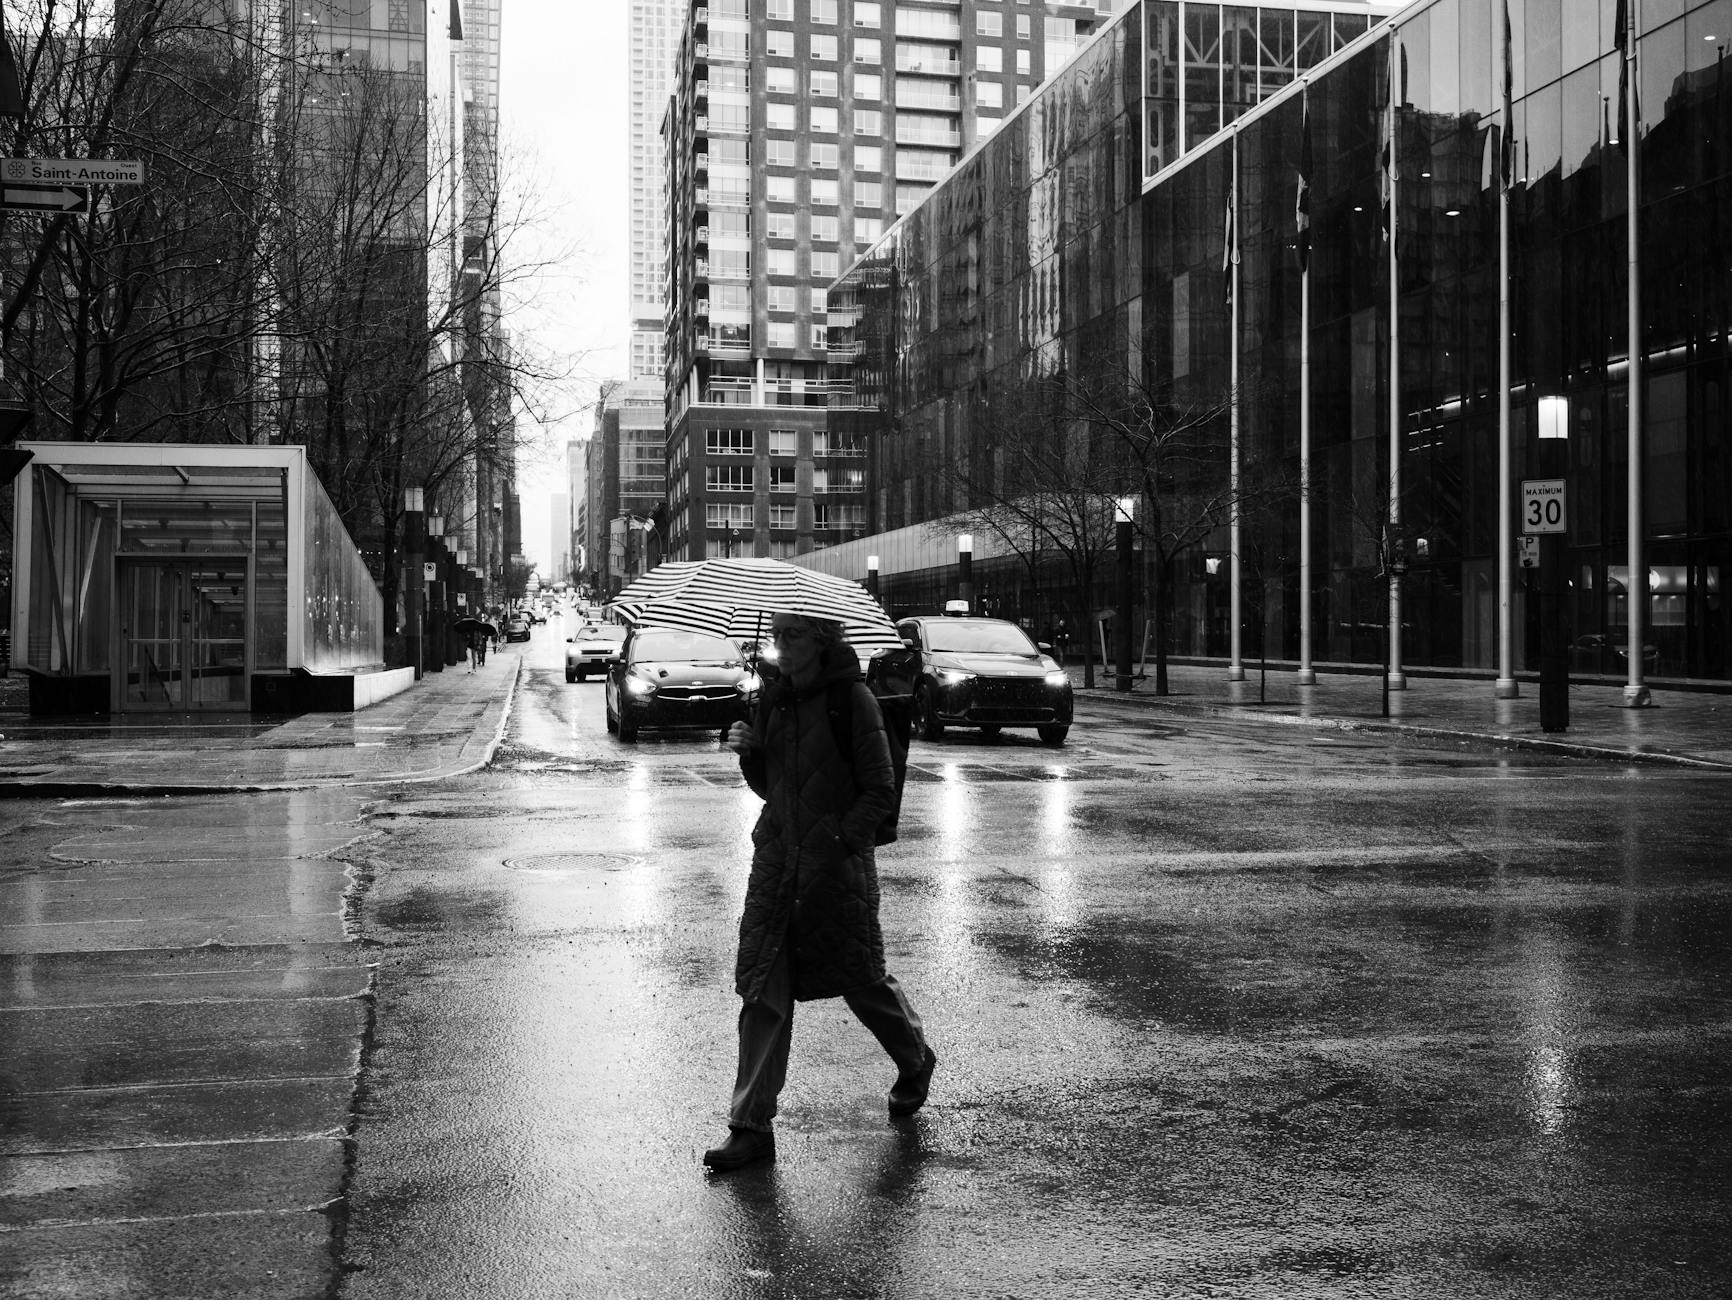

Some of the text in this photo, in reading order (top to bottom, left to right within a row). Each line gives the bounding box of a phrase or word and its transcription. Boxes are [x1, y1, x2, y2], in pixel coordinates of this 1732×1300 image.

[32, 166, 138, 180] Saint-Antoine
[1526, 487, 1562, 495] MAXIMUM
[1527, 499, 1561, 525] 30
[1525, 537, 1534, 548] P
